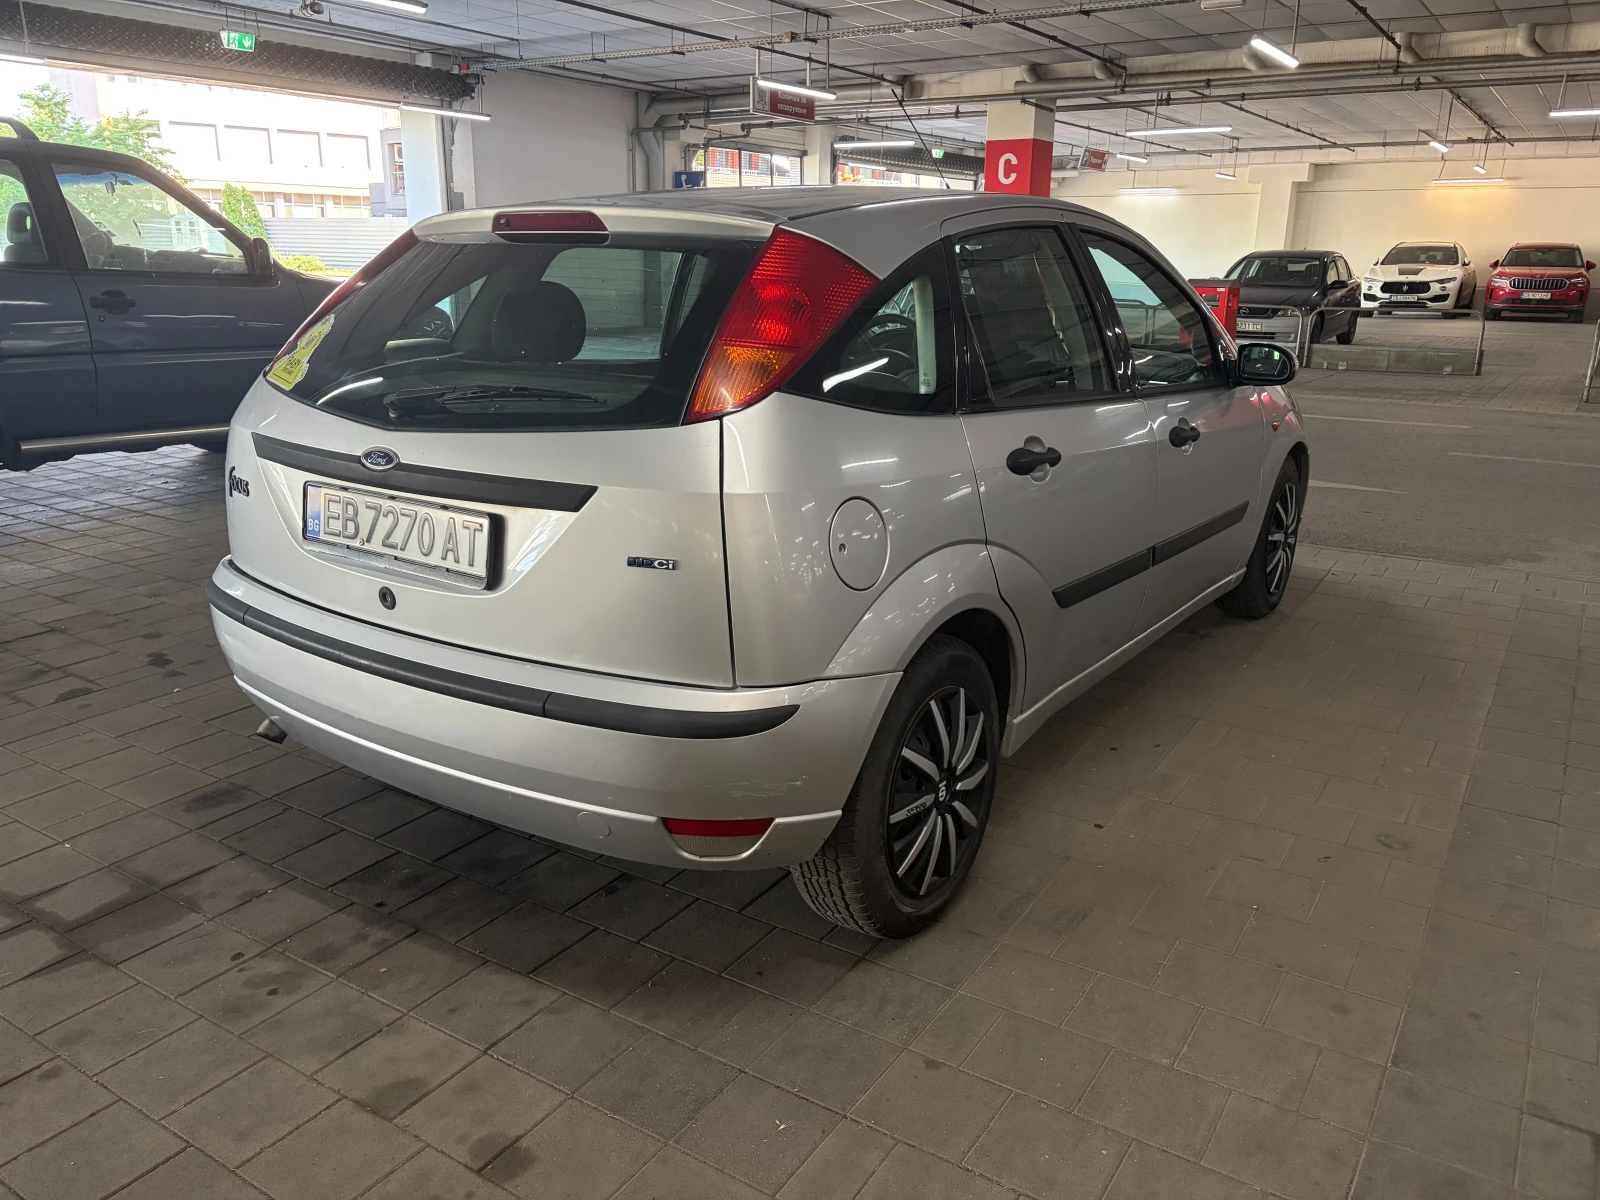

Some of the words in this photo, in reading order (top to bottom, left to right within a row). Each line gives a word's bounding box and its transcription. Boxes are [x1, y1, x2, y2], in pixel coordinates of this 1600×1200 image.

[998, 152, 1018, 185] C
[367, 451, 389, 465] Ford
[308, 518, 320, 532] BG
[323, 493, 360, 540] EB
[365, 500, 435, 557] 7270
[441, 516, 483, 567] AT
